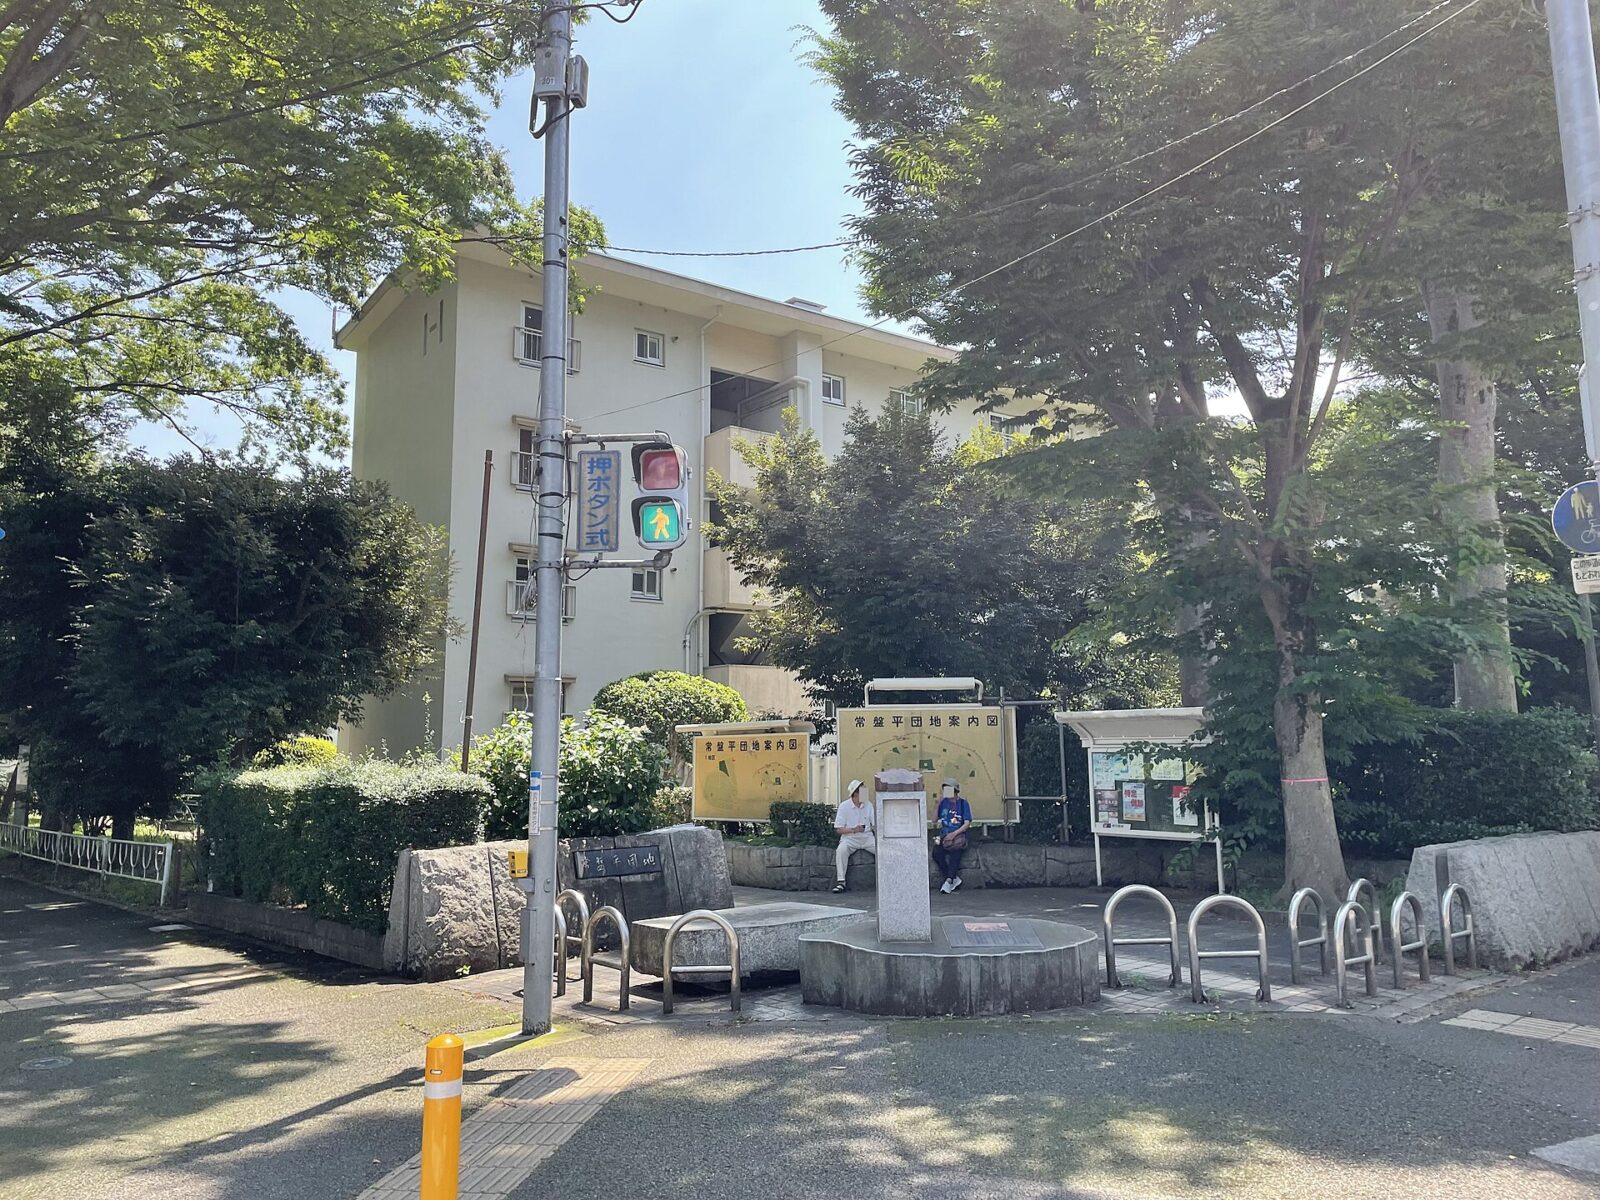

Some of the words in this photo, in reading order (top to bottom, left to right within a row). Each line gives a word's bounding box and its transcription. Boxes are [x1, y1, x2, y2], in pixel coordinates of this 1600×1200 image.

[585, 457, 612, 546] 押ボタン式
[854, 715, 998, 728] 常盤平団地案内図
[705, 738, 798, 752] 常盤平団地案内図
